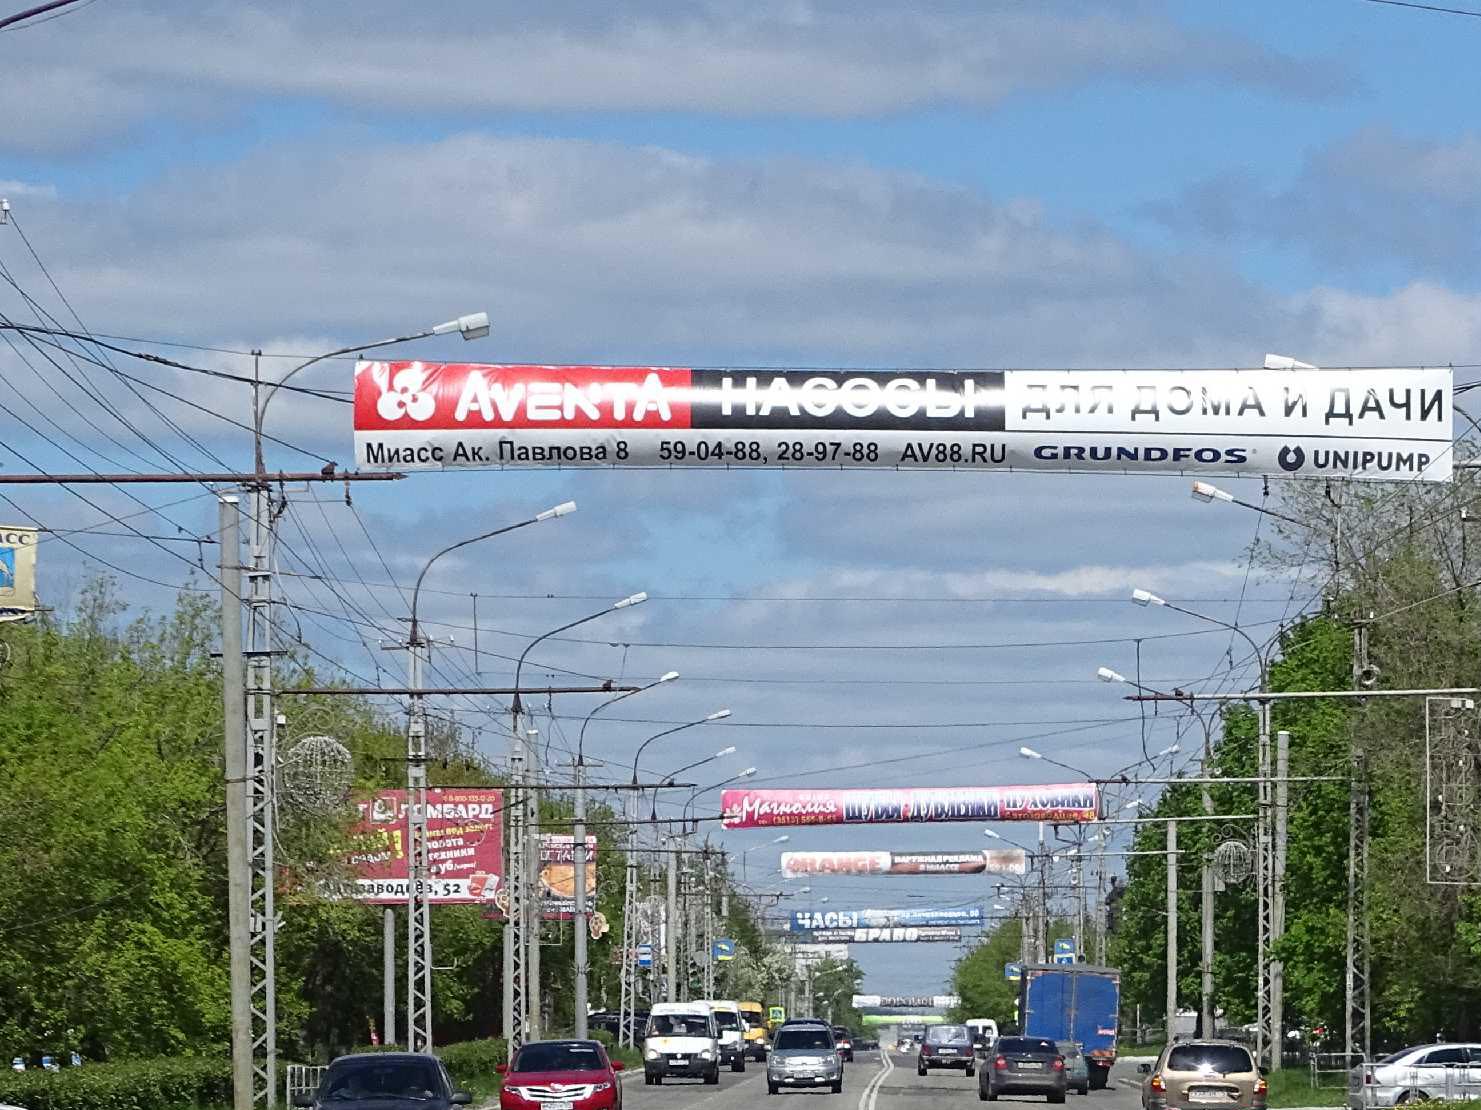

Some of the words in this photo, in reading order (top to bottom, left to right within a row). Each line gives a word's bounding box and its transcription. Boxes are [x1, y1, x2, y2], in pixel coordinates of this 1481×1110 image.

[455, 372, 672, 422] AVENTA
[721, 377, 976, 418] НАСОСЫ
[1021, 383, 1116, 421] ДЛЯ
[1131, 384, 1267, 422] ДОМА
[1325, 387, 1444, 426] ДАЧИ
[366, 442, 445, 465] Миасс
[453, 440, 491, 463] Ак.
[499, 440, 608, 462] Павлова
[616, 440, 629, 460] 8
[659, 441, 768, 465] 59-04-88,
[777, 441, 879, 463] 28-97-88
[902, 443, 1007, 464] AV88.RU
[1033, 445, 1248, 464] GRUNDFOS
[1313, 449, 1431, 472] UNIPUMP
[443, 882, 461, 897] 52
[796, 911, 859, 929] ЧАСЫ
